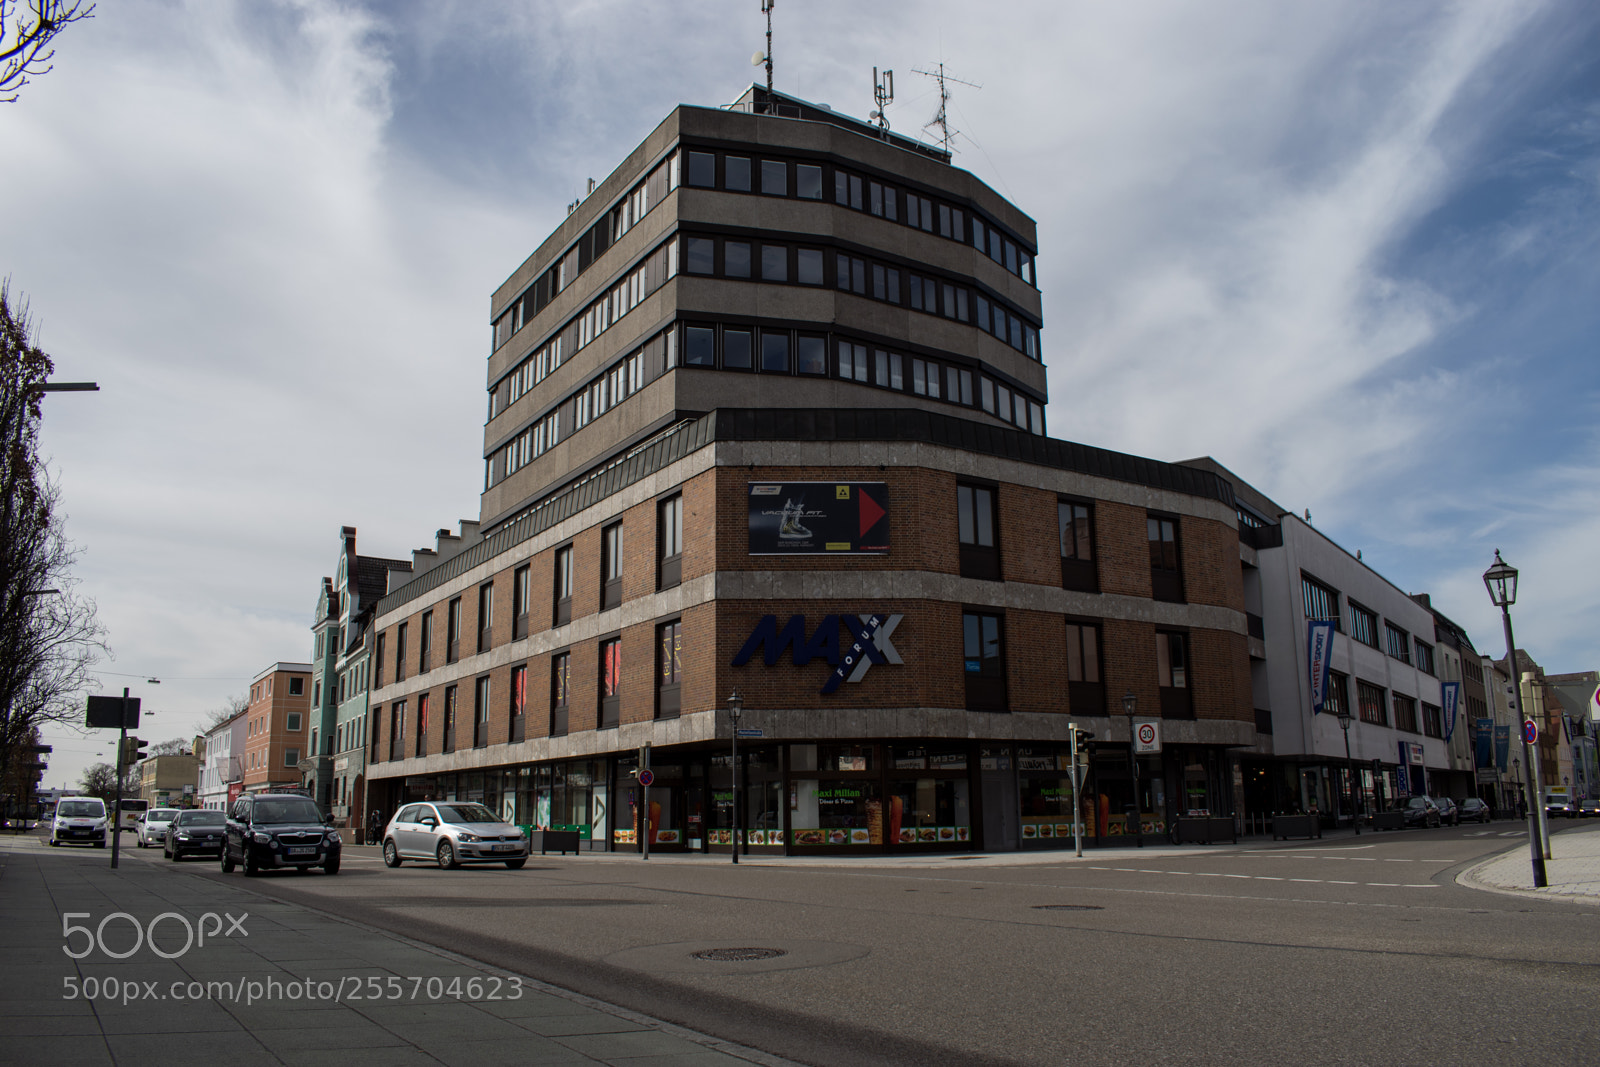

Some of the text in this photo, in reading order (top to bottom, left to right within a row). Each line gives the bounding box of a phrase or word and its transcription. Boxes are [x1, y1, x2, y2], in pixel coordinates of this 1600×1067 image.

[836, 615, 881, 676] FORUM
[1312, 632, 1324, 689] INTERSPORT
[1142, 729, 1152, 739] 30
